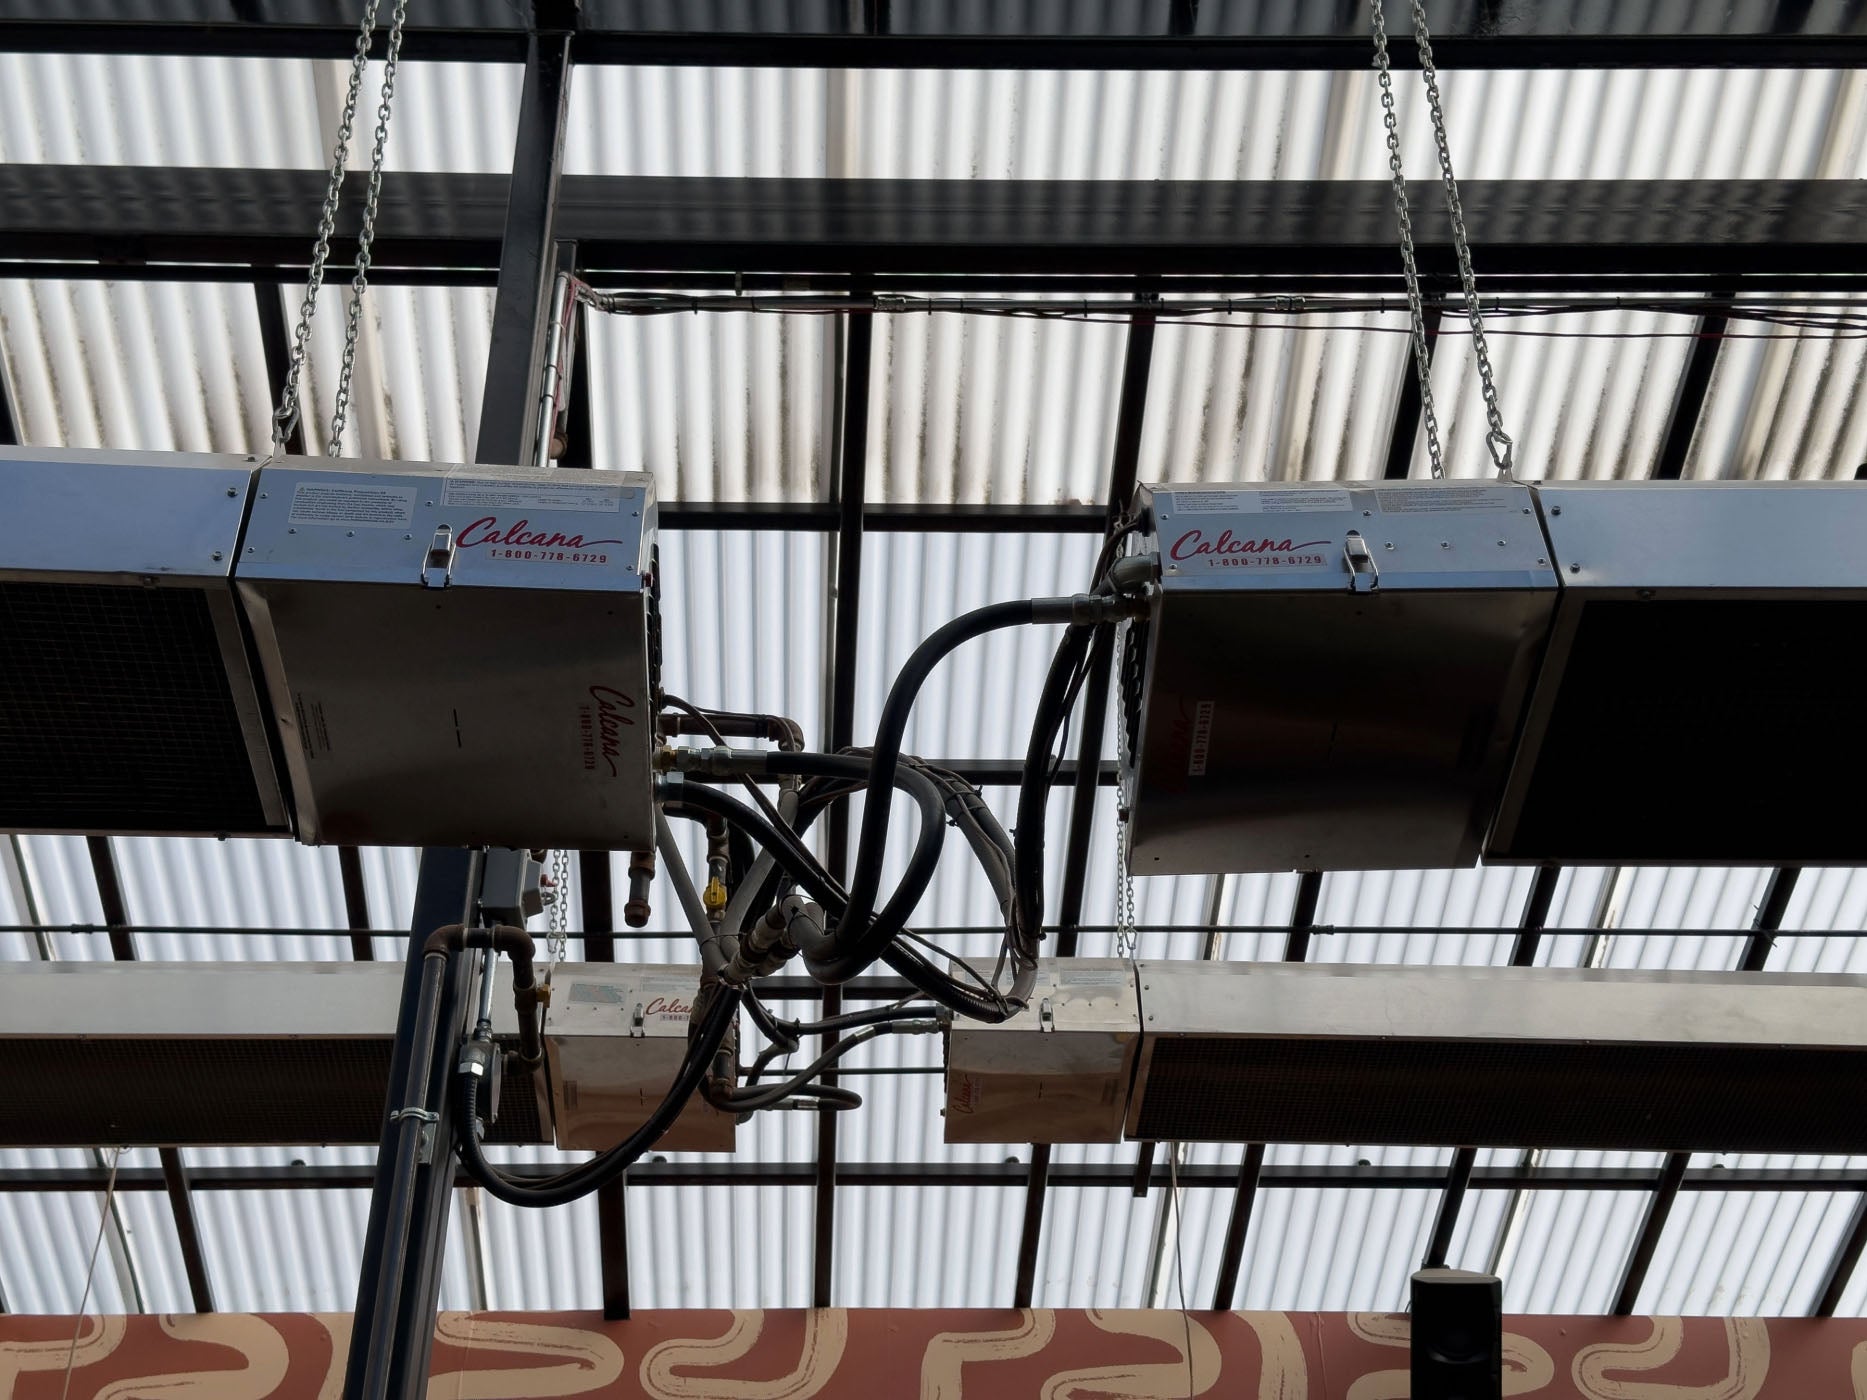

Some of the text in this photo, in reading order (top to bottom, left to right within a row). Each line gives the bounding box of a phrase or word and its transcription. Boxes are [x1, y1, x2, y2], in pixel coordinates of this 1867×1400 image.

[456, 516, 623, 548] Calcana
[490, 549, 608, 564] 1-800-778-6729
[1170, 529, 1332, 561] Calcana
[1208, 555, 1322, 567] 1-800-778-6729
[589, 685, 635, 777] Calcana
[645, 997, 693, 1015] Calca
